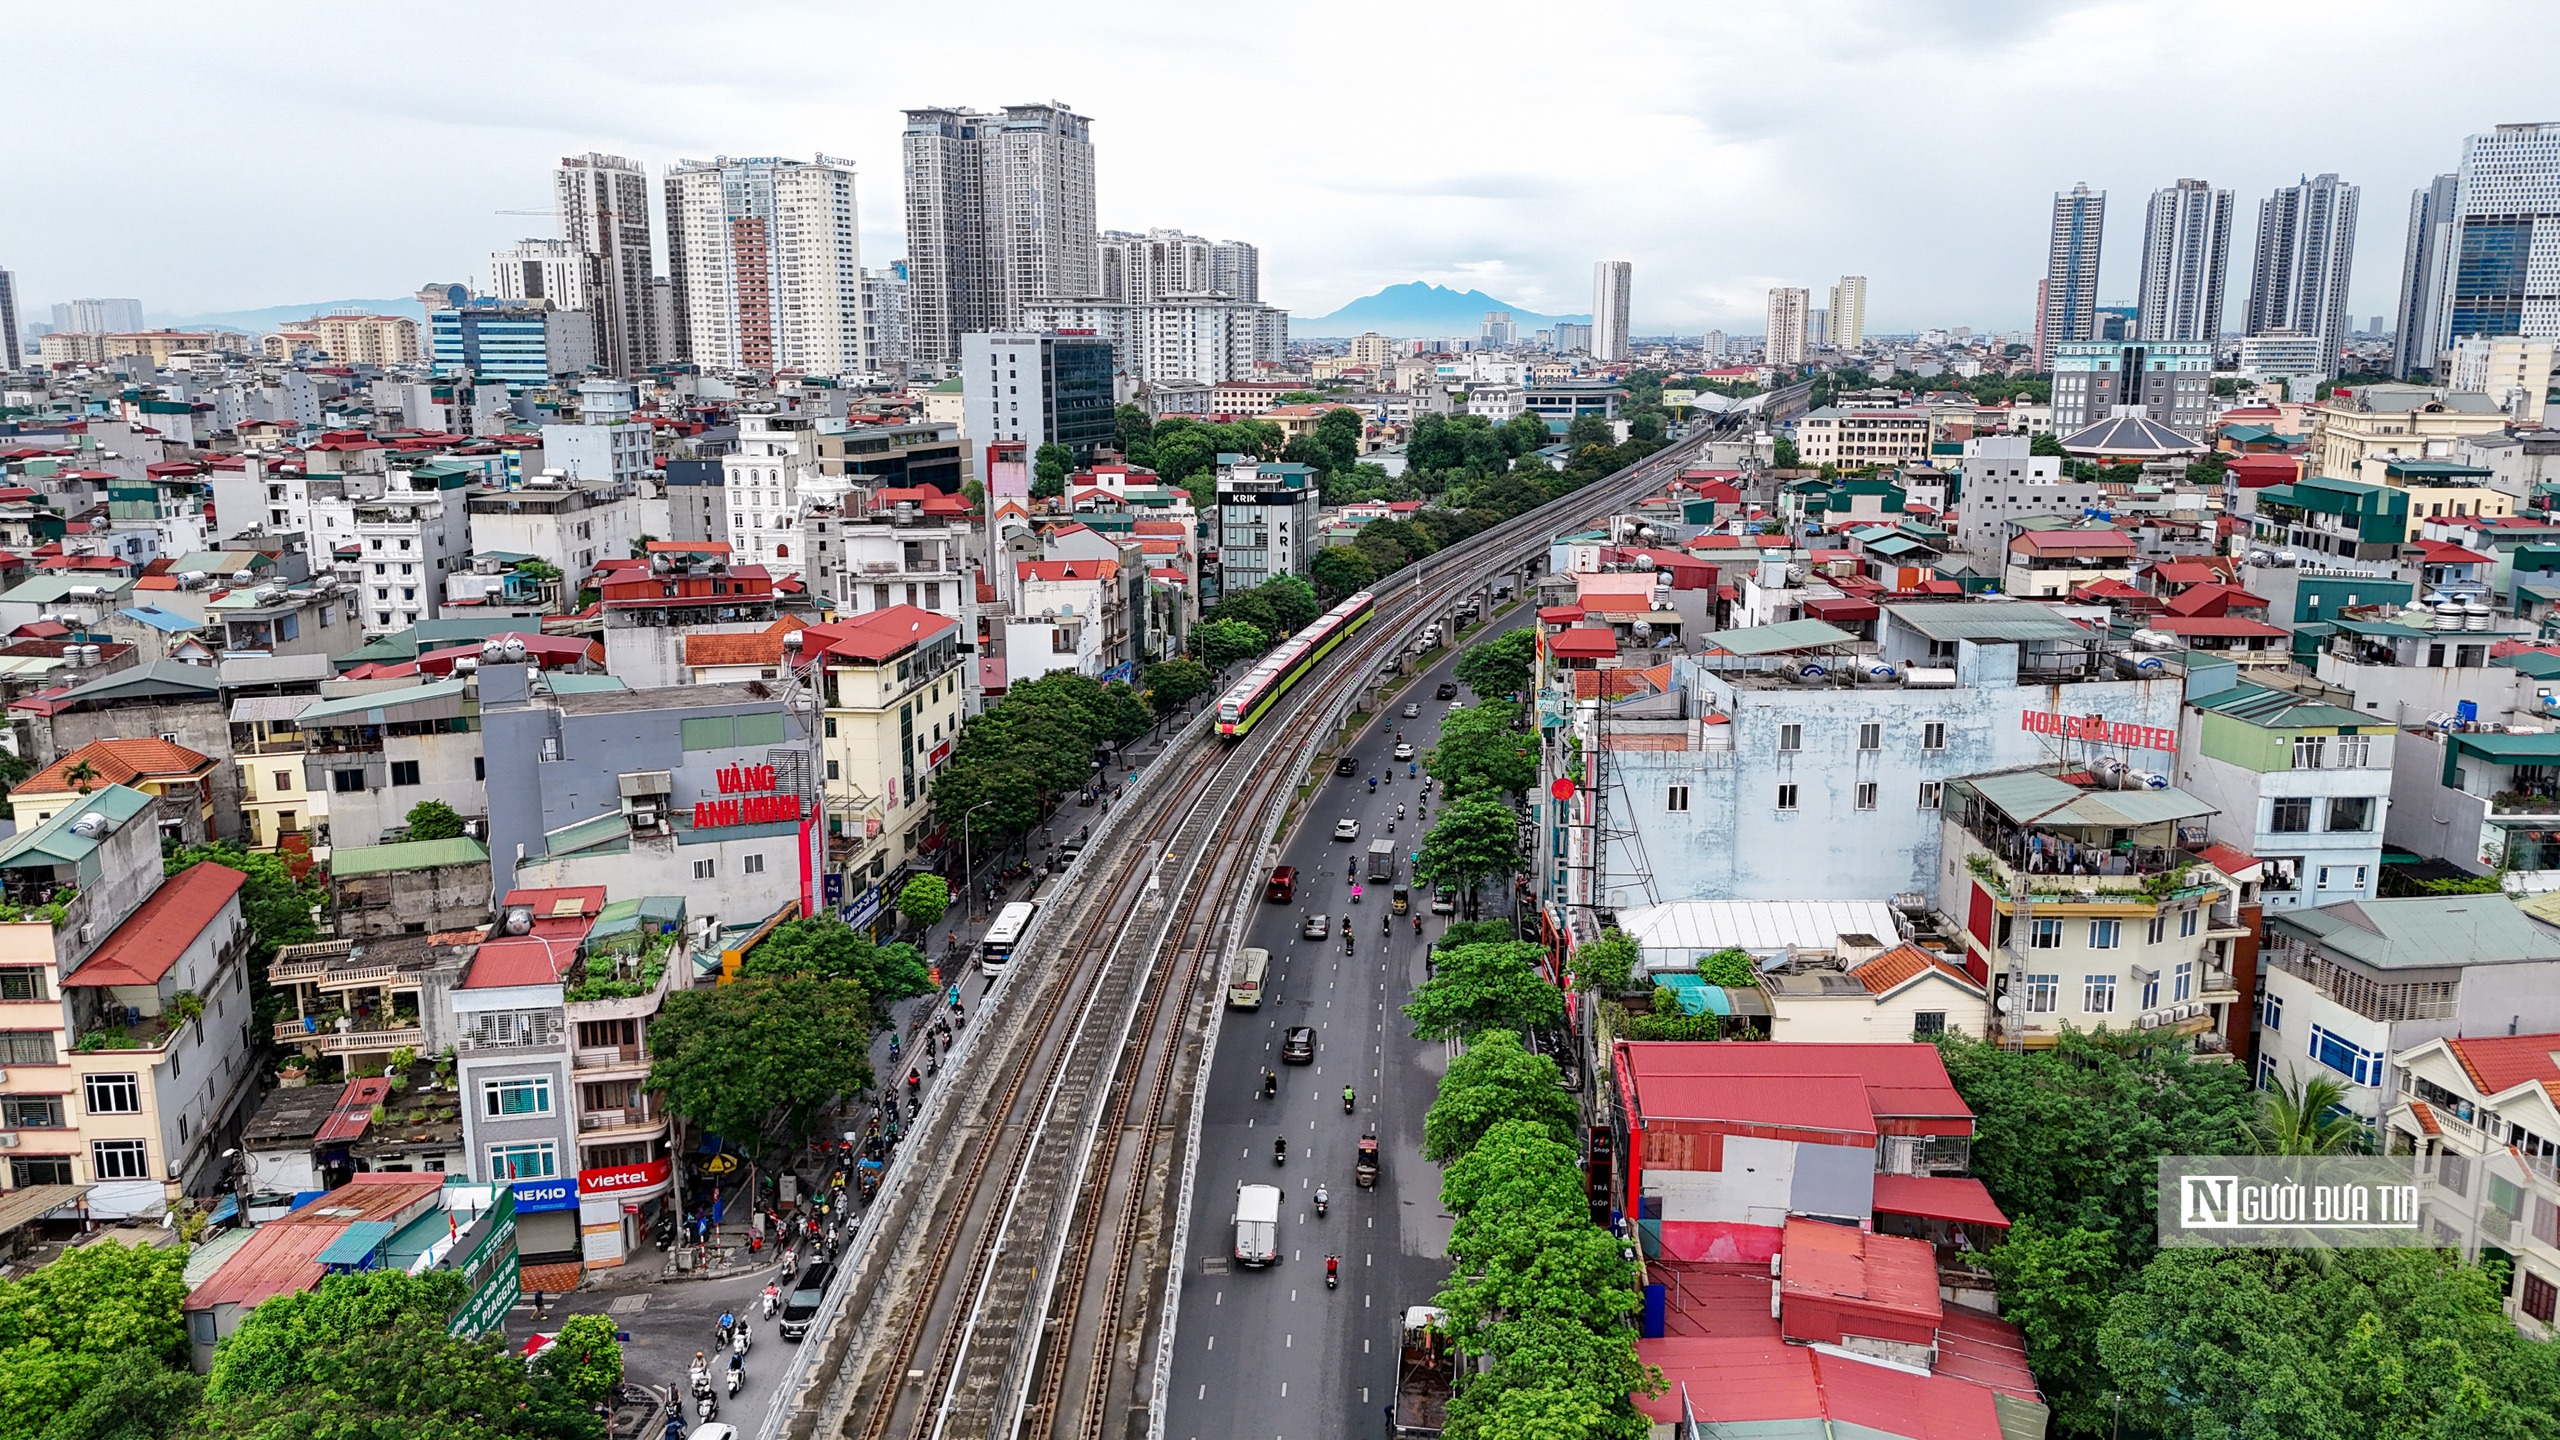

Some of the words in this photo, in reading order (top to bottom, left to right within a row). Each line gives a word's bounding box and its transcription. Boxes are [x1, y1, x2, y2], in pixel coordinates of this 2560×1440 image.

[1233, 494, 1257, 503] KRIK
[2022, 710, 2061, 735] HOA
[2113, 722, 2178, 752] HOTEL
[716, 762, 776, 794] VÀNG
[693, 799, 739, 829] ANH
[743, 794, 799, 823] MINH
[587, 1170, 648, 1188] viettel
[513, 1188, 566, 1202] NEKIO
[498, 1271, 505, 1284] XE
[482, 1275, 517, 1326] PIAGGIO
